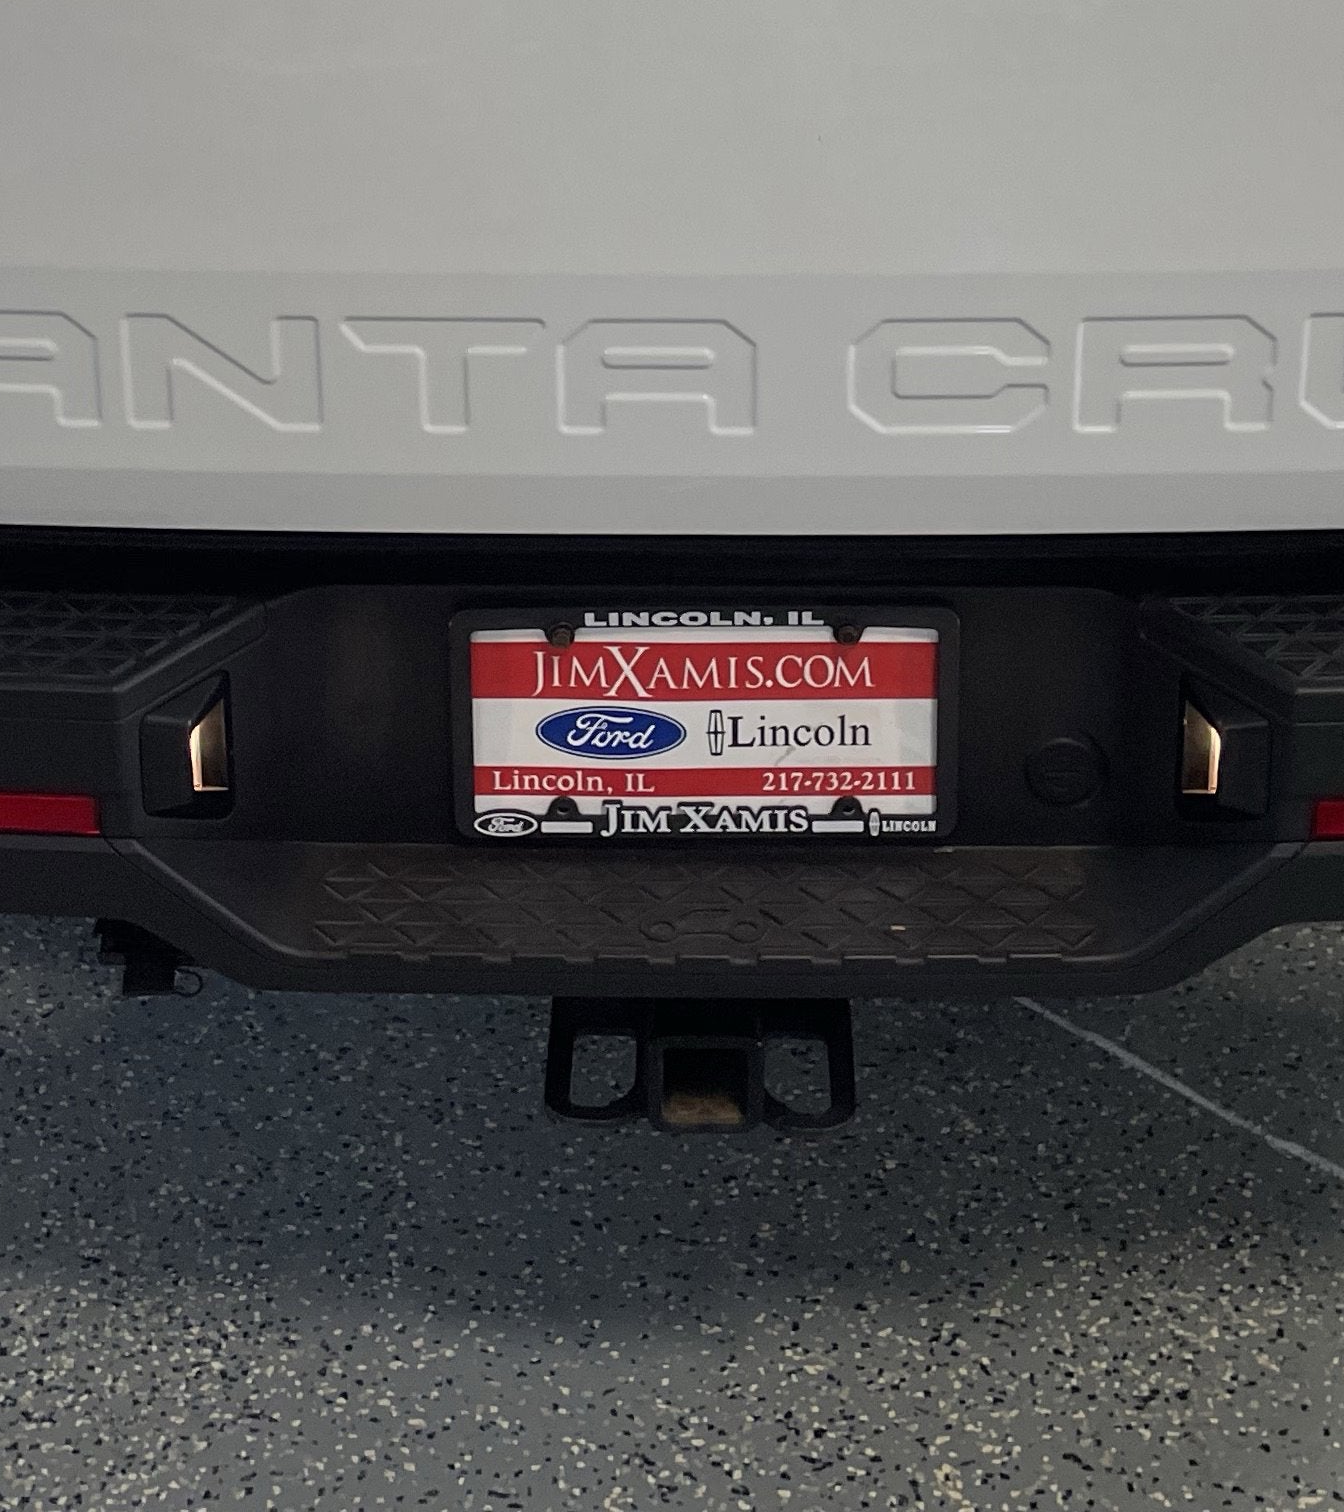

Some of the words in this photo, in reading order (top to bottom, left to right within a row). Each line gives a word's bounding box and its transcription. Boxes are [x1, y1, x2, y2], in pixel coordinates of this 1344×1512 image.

[787, 611, 824, 626] IL
[567, 714, 656, 750] Ford
[727, 715, 872, 748] Lincoln
[492, 770, 613, 794] Lincoln,
[625, 773, 655, 792] IL
[763, 771, 916, 792] 217-732-2111
[488, 816, 523, 833] Ford
[882, 820, 937, 832] LINCOLN
